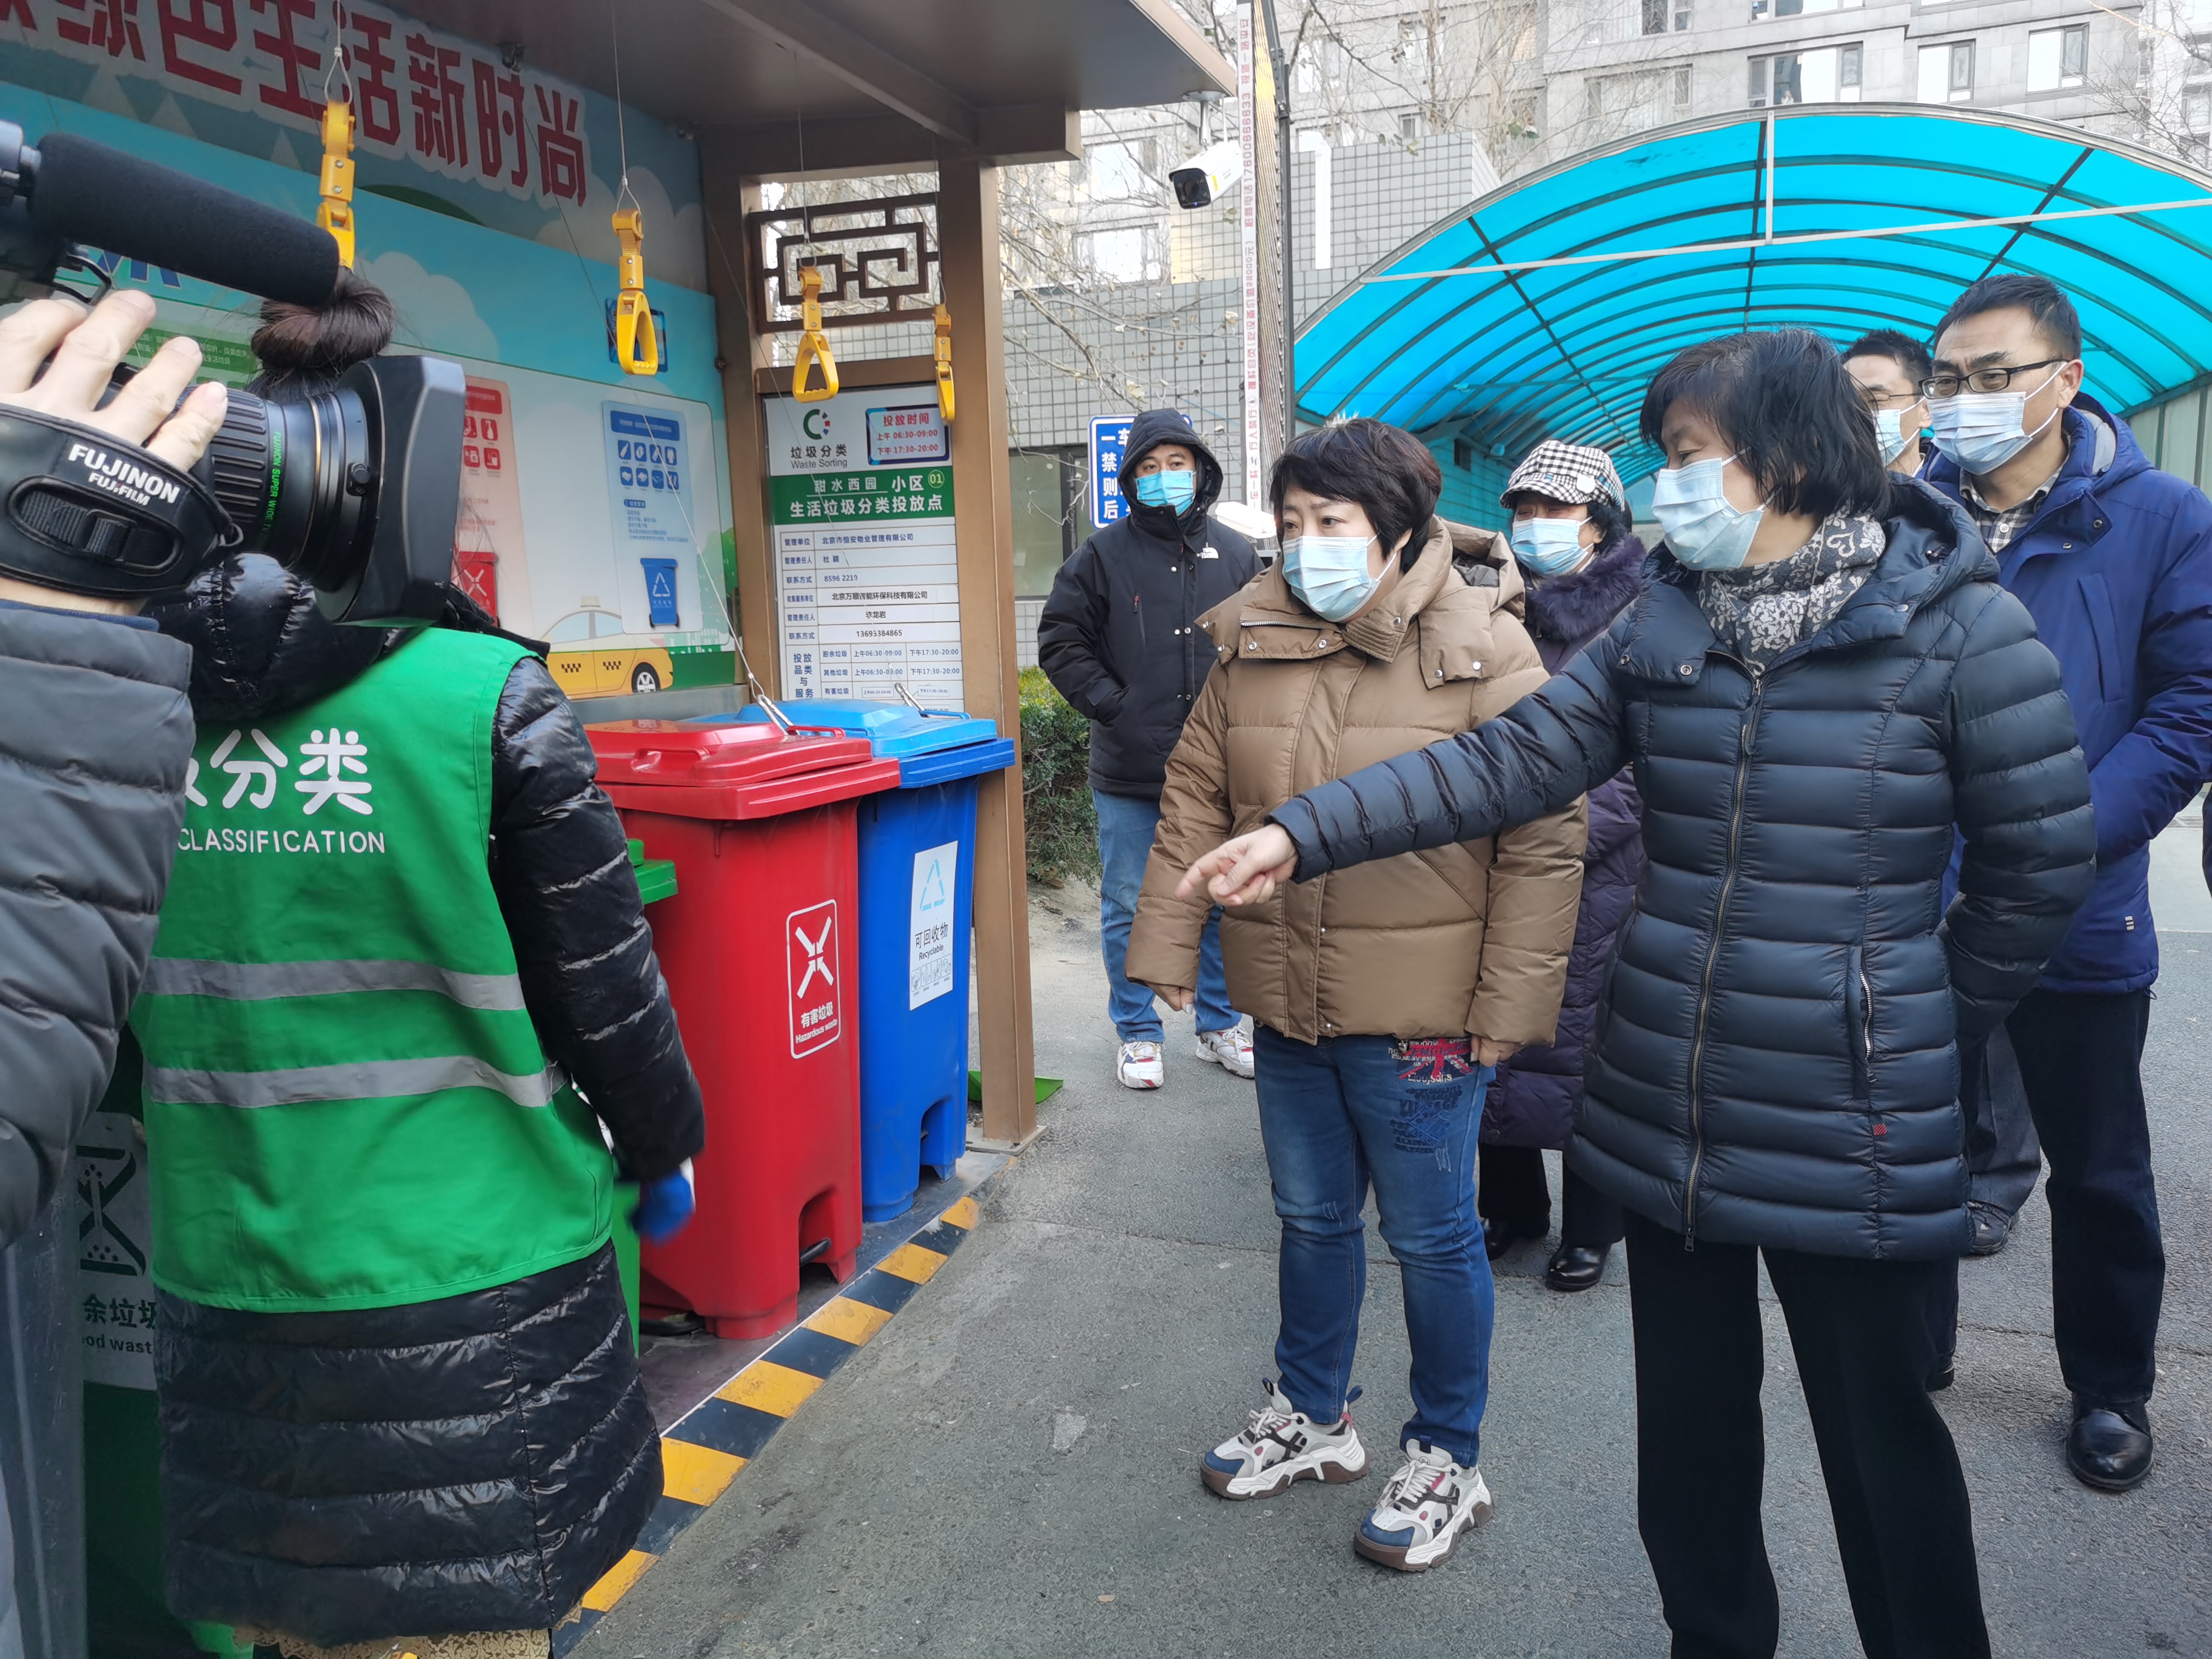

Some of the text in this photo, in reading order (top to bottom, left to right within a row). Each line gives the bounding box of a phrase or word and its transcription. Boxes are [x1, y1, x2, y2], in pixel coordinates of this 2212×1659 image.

[883, 413, 930, 427] 投放时间
[876, 430, 938, 441] 上午 06:30-09:00
[790, 443, 847, 460] 垃圾分类
[877, 444, 939, 455] 下午 17:30-20:00
[790, 458, 848, 471] Waste Sorting
[68, 444, 180, 504] FUJINON
[264, 431, 282, 520] FUJINON SUPER WIDE
[89, 472, 150, 506] FUJIFILM
[814, 474, 942, 493] 甜水西园 小区 01
[789, 494, 943, 518] 生活垃圾分类投放点
[789, 632, 815, 640] 联系方式
[856, 629, 902, 638] 13693384865
[793, 653, 812, 663] 投放
[854, 649, 902, 657] 上午06:30-09:00
[910, 648, 959, 657] 下午17:30-20:00
[794, 665, 813, 675] 品类
[823, 668, 848, 677] 其他垃圾
[910, 667, 960, 675] 下午17:30-20:00
[799, 677, 808, 686] 与
[795, 689, 814, 698] 服务
[825, 687, 850, 695] 有害垃圾
[178, 828, 385, 854] CLASSIFICATION
[915, 922, 948, 948] 可回收物
[919, 943, 944, 960] Recyclable
[800, 1001, 833, 1029] 有害垃圾
[796, 1019, 838, 1044] Hazardous waste
